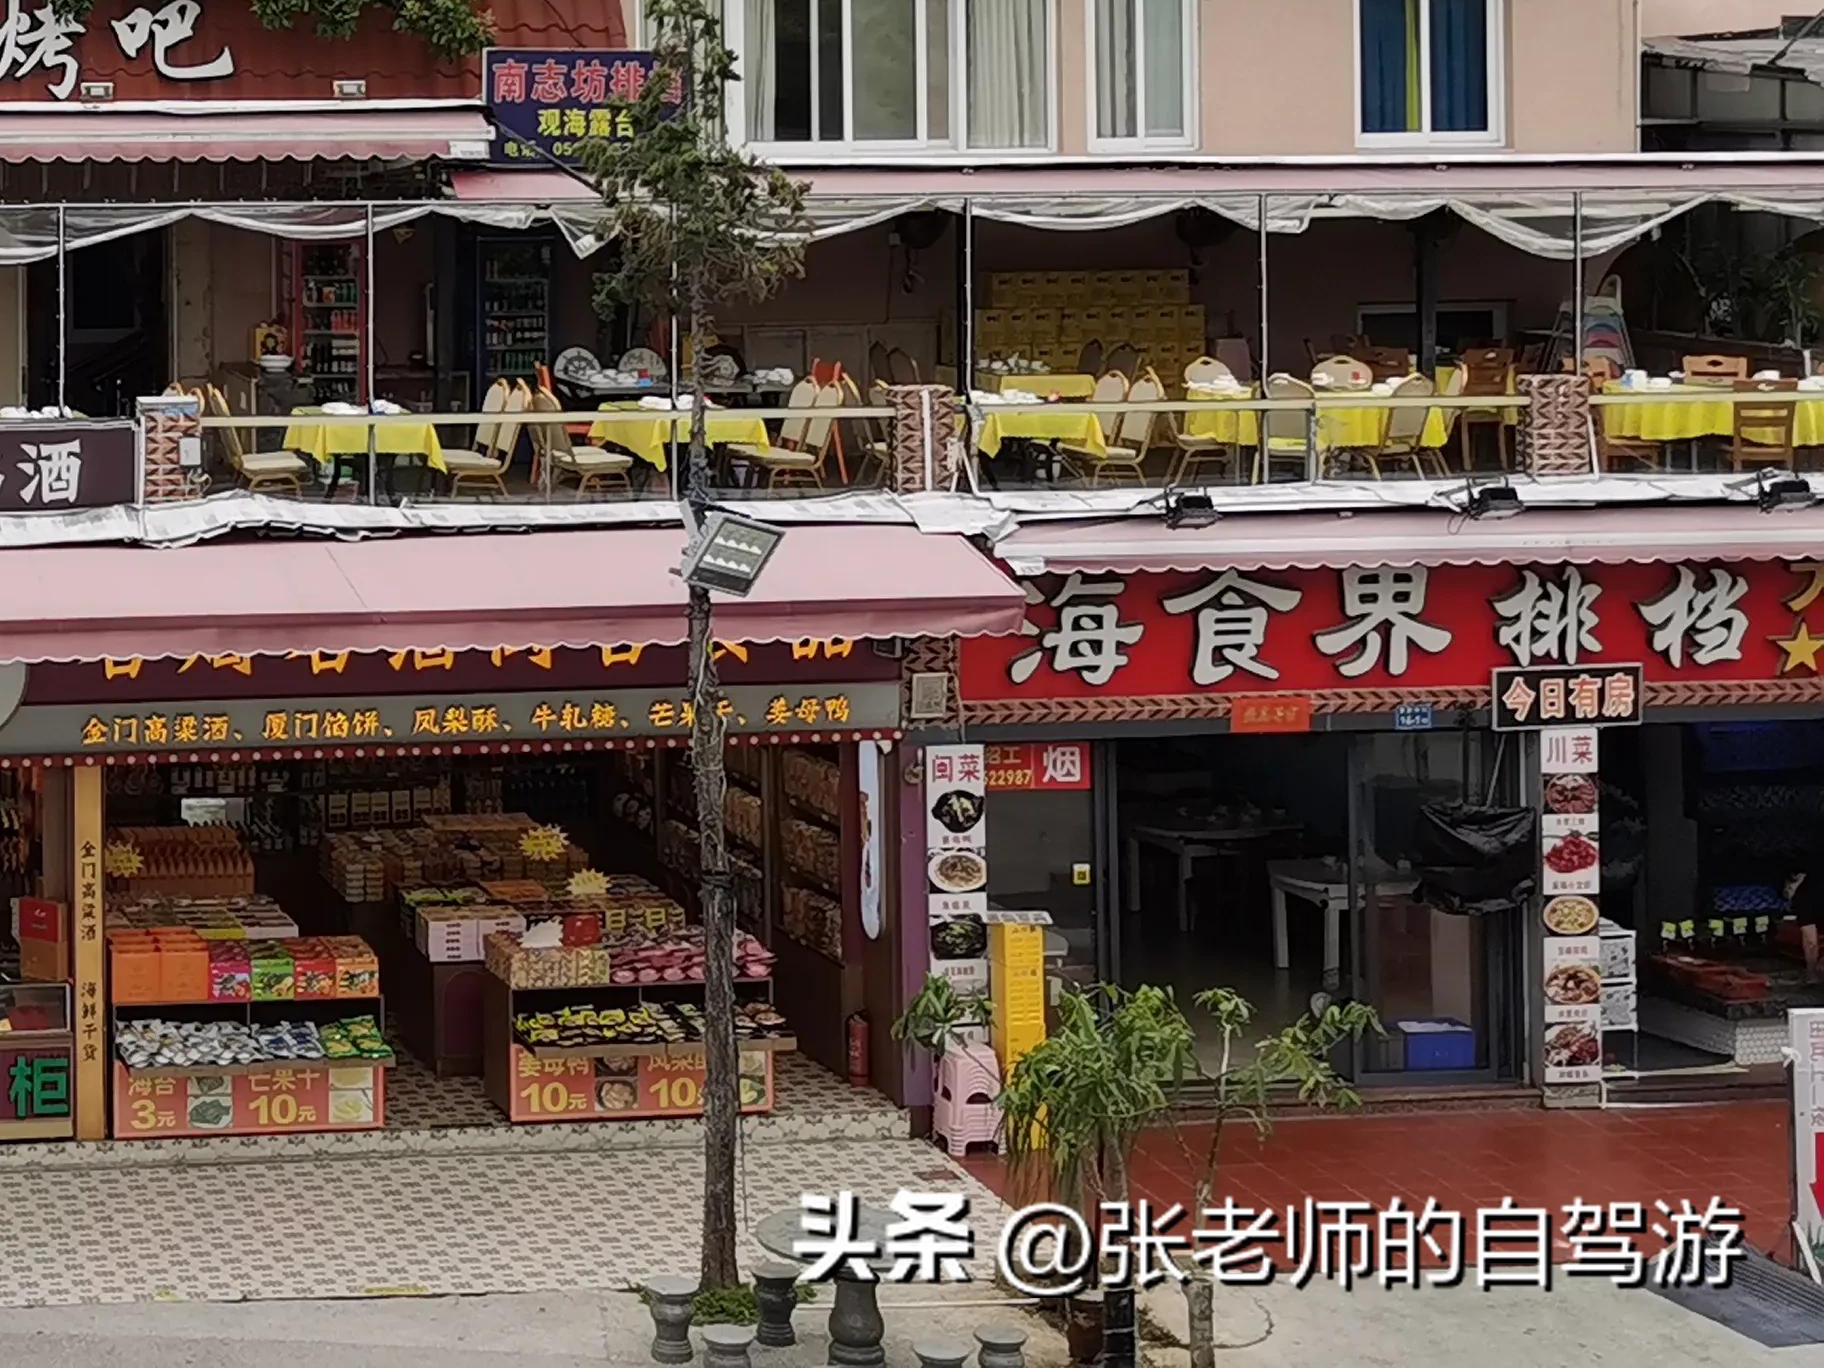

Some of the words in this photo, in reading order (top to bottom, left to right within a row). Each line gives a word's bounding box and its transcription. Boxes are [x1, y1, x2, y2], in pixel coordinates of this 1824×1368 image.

[537, 109, 636, 137] 观海露台
[1008, 564, 1748, 686] 海食界排档
[1501, 672, 1635, 722] 今日有房
[1043, 745, 1082, 784] 烟
[1546, 735, 1594, 765] 川菜
[932, 753, 981, 784] 闽菜
[79, 981, 98, 1062] 海鲜干货
[520, 1081, 589, 1114] 10元
[649, 1078, 707, 1109] 10
[130, 1099, 177, 1130] 3元
[249, 1094, 317, 1126] 10元
